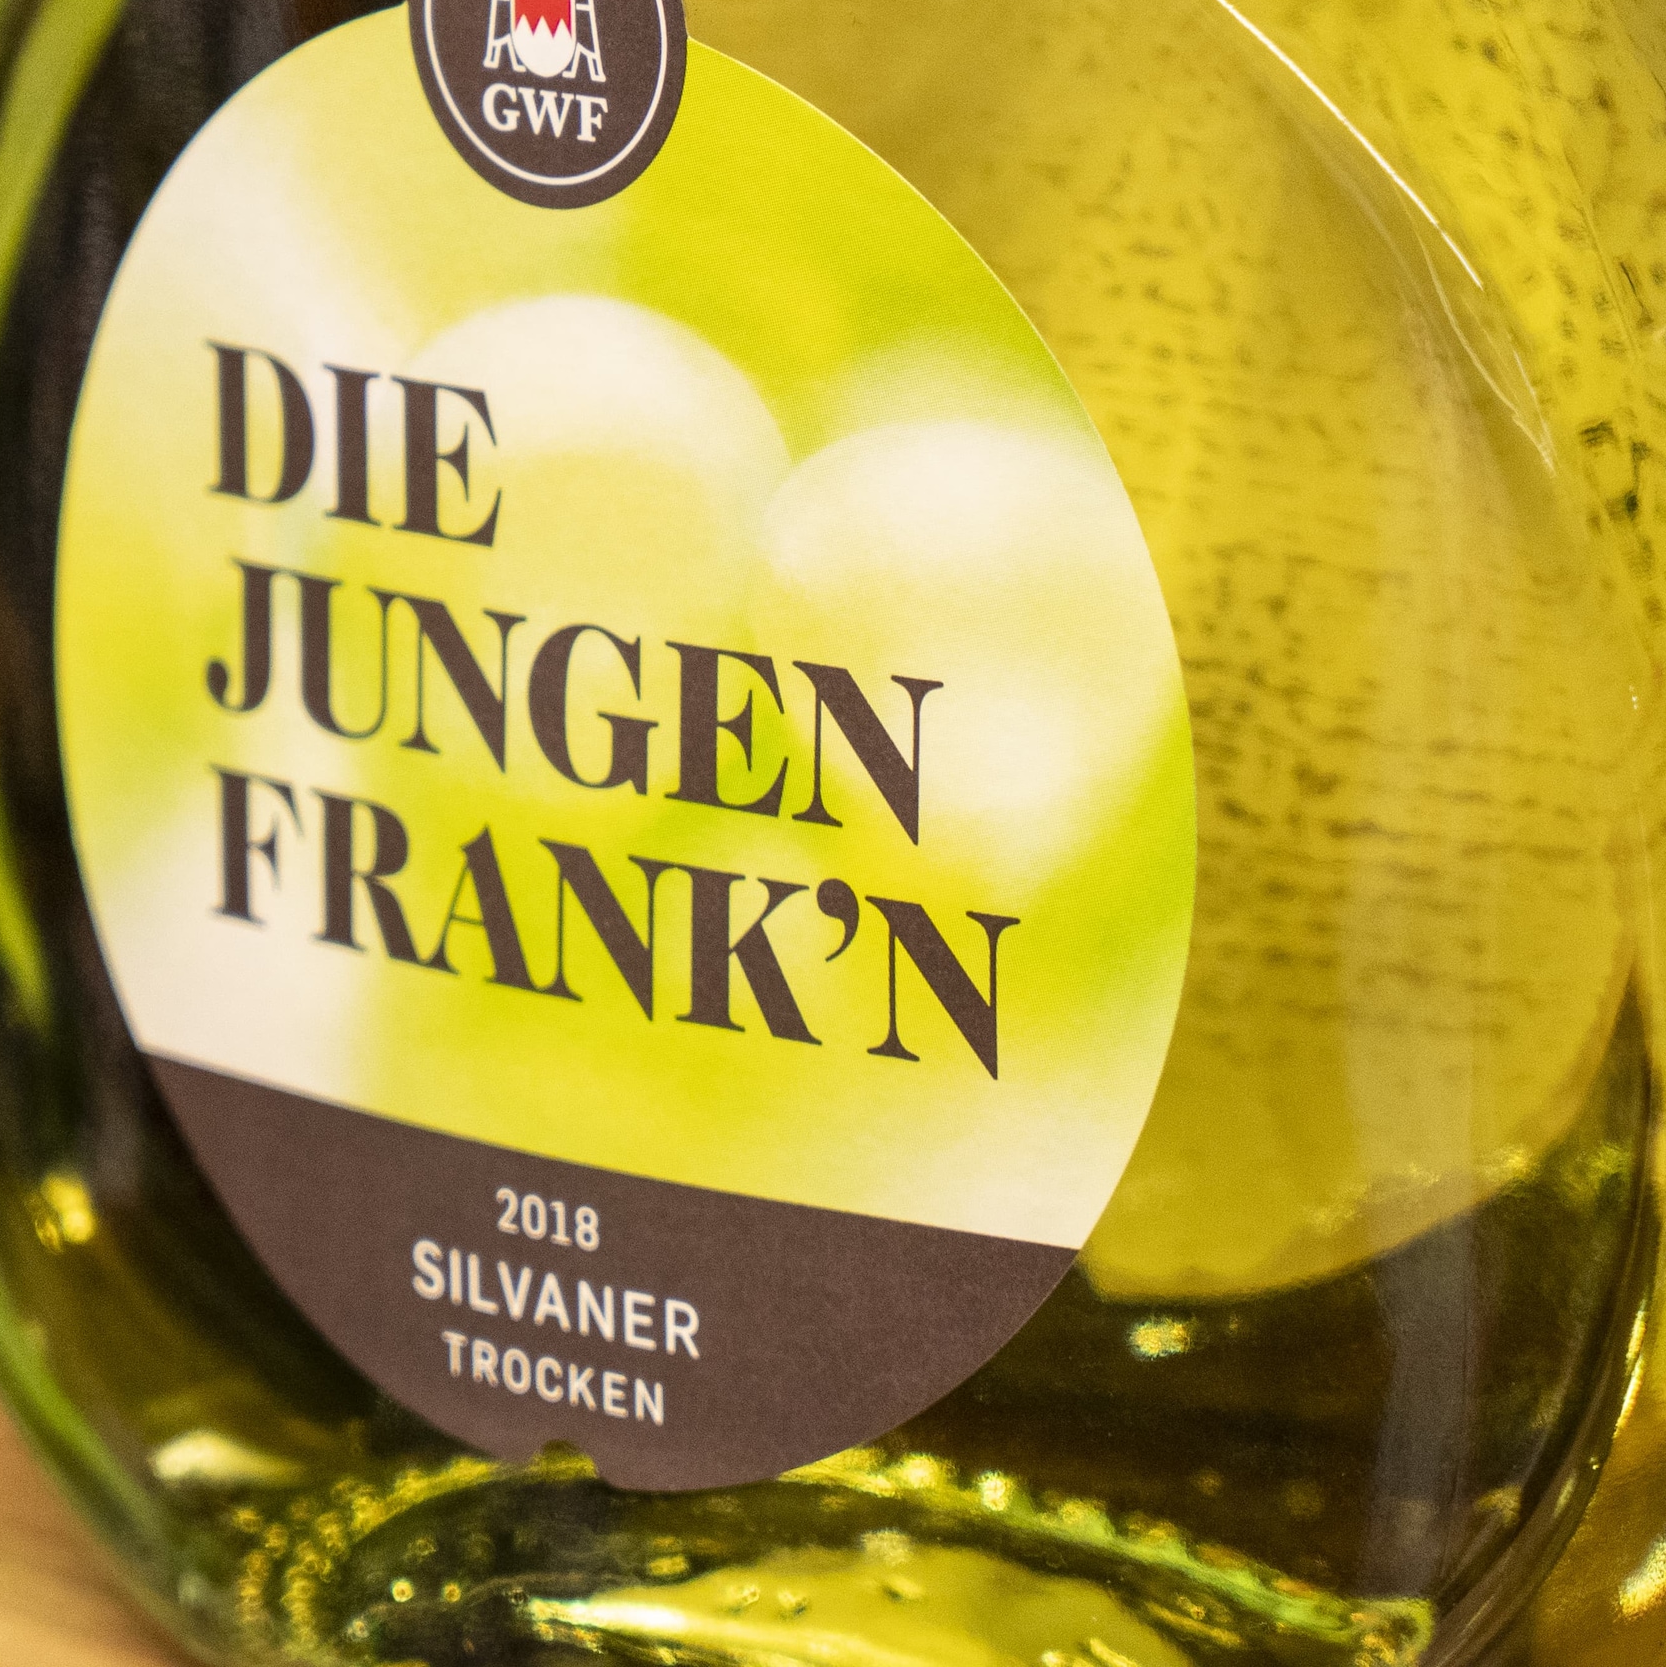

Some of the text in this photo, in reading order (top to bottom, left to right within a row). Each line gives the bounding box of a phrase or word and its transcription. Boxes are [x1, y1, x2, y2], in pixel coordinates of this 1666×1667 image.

[481, 81, 609, 144] GWF
[204, 338, 503, 548] DIE
[205, 558, 945, 847] JUNGEN
[208, 762, 1021, 1081] FRANK’N
[495, 1187, 601, 1252] 2018
[411, 1240, 701, 1359] SILVANER
[442, 1330, 667, 1426] TROCKEN
